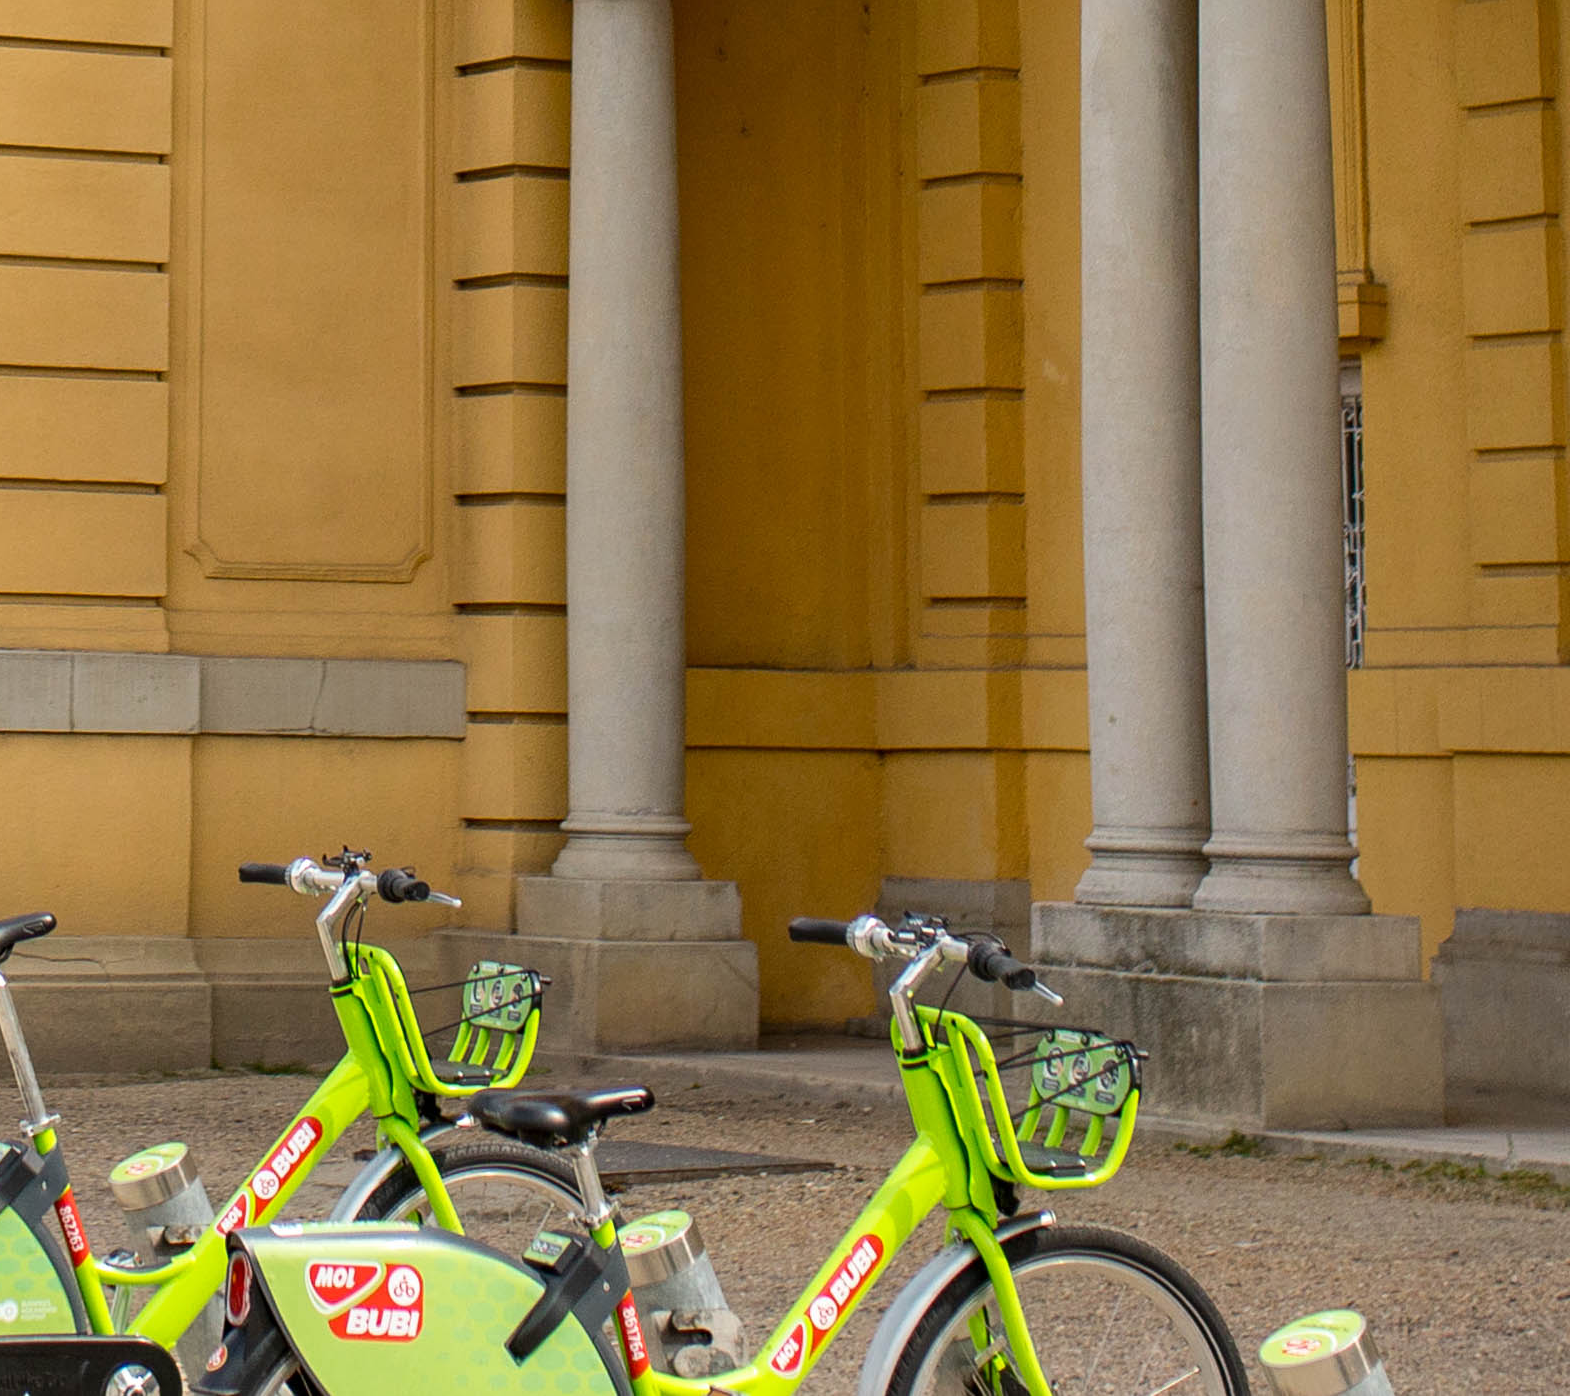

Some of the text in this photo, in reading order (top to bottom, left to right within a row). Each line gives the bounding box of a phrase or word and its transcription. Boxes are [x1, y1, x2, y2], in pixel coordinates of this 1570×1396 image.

[220, 1122, 317, 1233] MOL BUBI
[315, 1266, 356, 1289] MOL
[774, 1239, 878, 1370] MOL BUBI
[346, 1307, 420, 1337] BUBI
